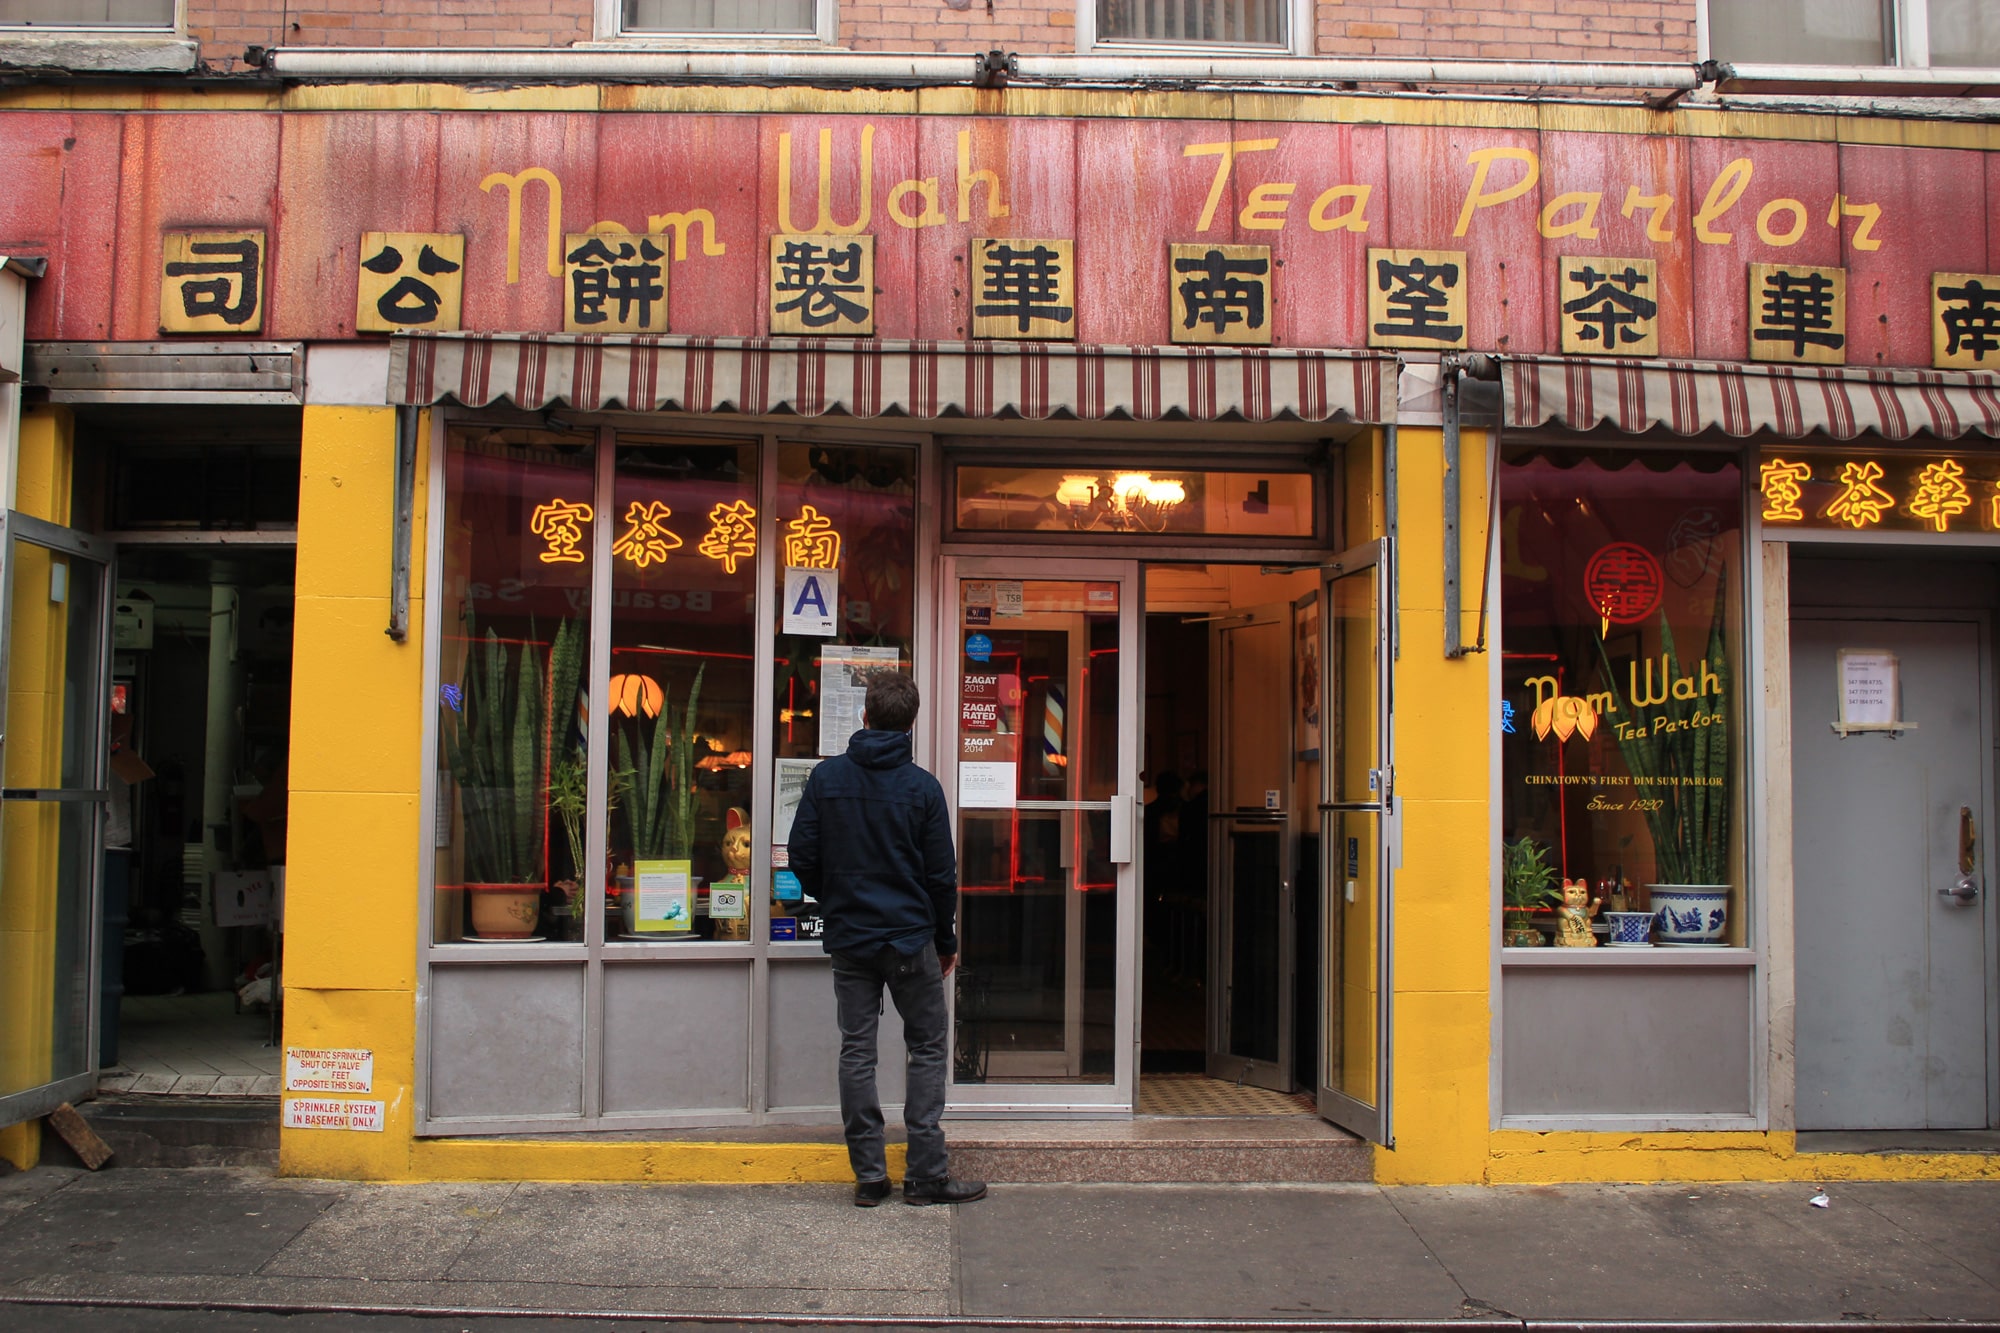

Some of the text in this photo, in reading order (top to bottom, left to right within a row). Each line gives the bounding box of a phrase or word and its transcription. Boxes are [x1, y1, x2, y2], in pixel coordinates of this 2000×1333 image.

[479, 123, 1883, 284] Nm Wah Tea Parlor
[1086, 485, 1114, 512] 13
[792, 576, 828, 616] A
[964, 676, 997, 684] ZAGAT
[964, 684, 984, 692] 2013
[1524, 675, 1617, 724] Nom
[1630, 653, 1722, 708] Wah
[963, 703, 997, 712] ZAGAT
[962, 711, 996, 720] RATED
[1614, 711, 1723, 741] Tea Parlor
[964, 738, 994, 746] ZAGAT
[1525, 775, 1723, 786] CHINATOWN'S FIRST DIM SUM PARLOR
[1587, 795, 1664, 811] Since 1920
[291, 1050, 370, 1061] AUTOMATIC SPRINKLER
[300, 1060, 360, 1070] SHUT OFF VALVE
[332, 1071, 350, 1079] FEET
[293, 1080, 329, 1088] OPPOSITE
[331, 1081, 346, 1089] THIS
[293, 1102, 376, 1115] SPRINKLER SYSTEM
[293, 1114, 302, 1124] IN
[305, 1115, 349, 1126] BASEMENT
